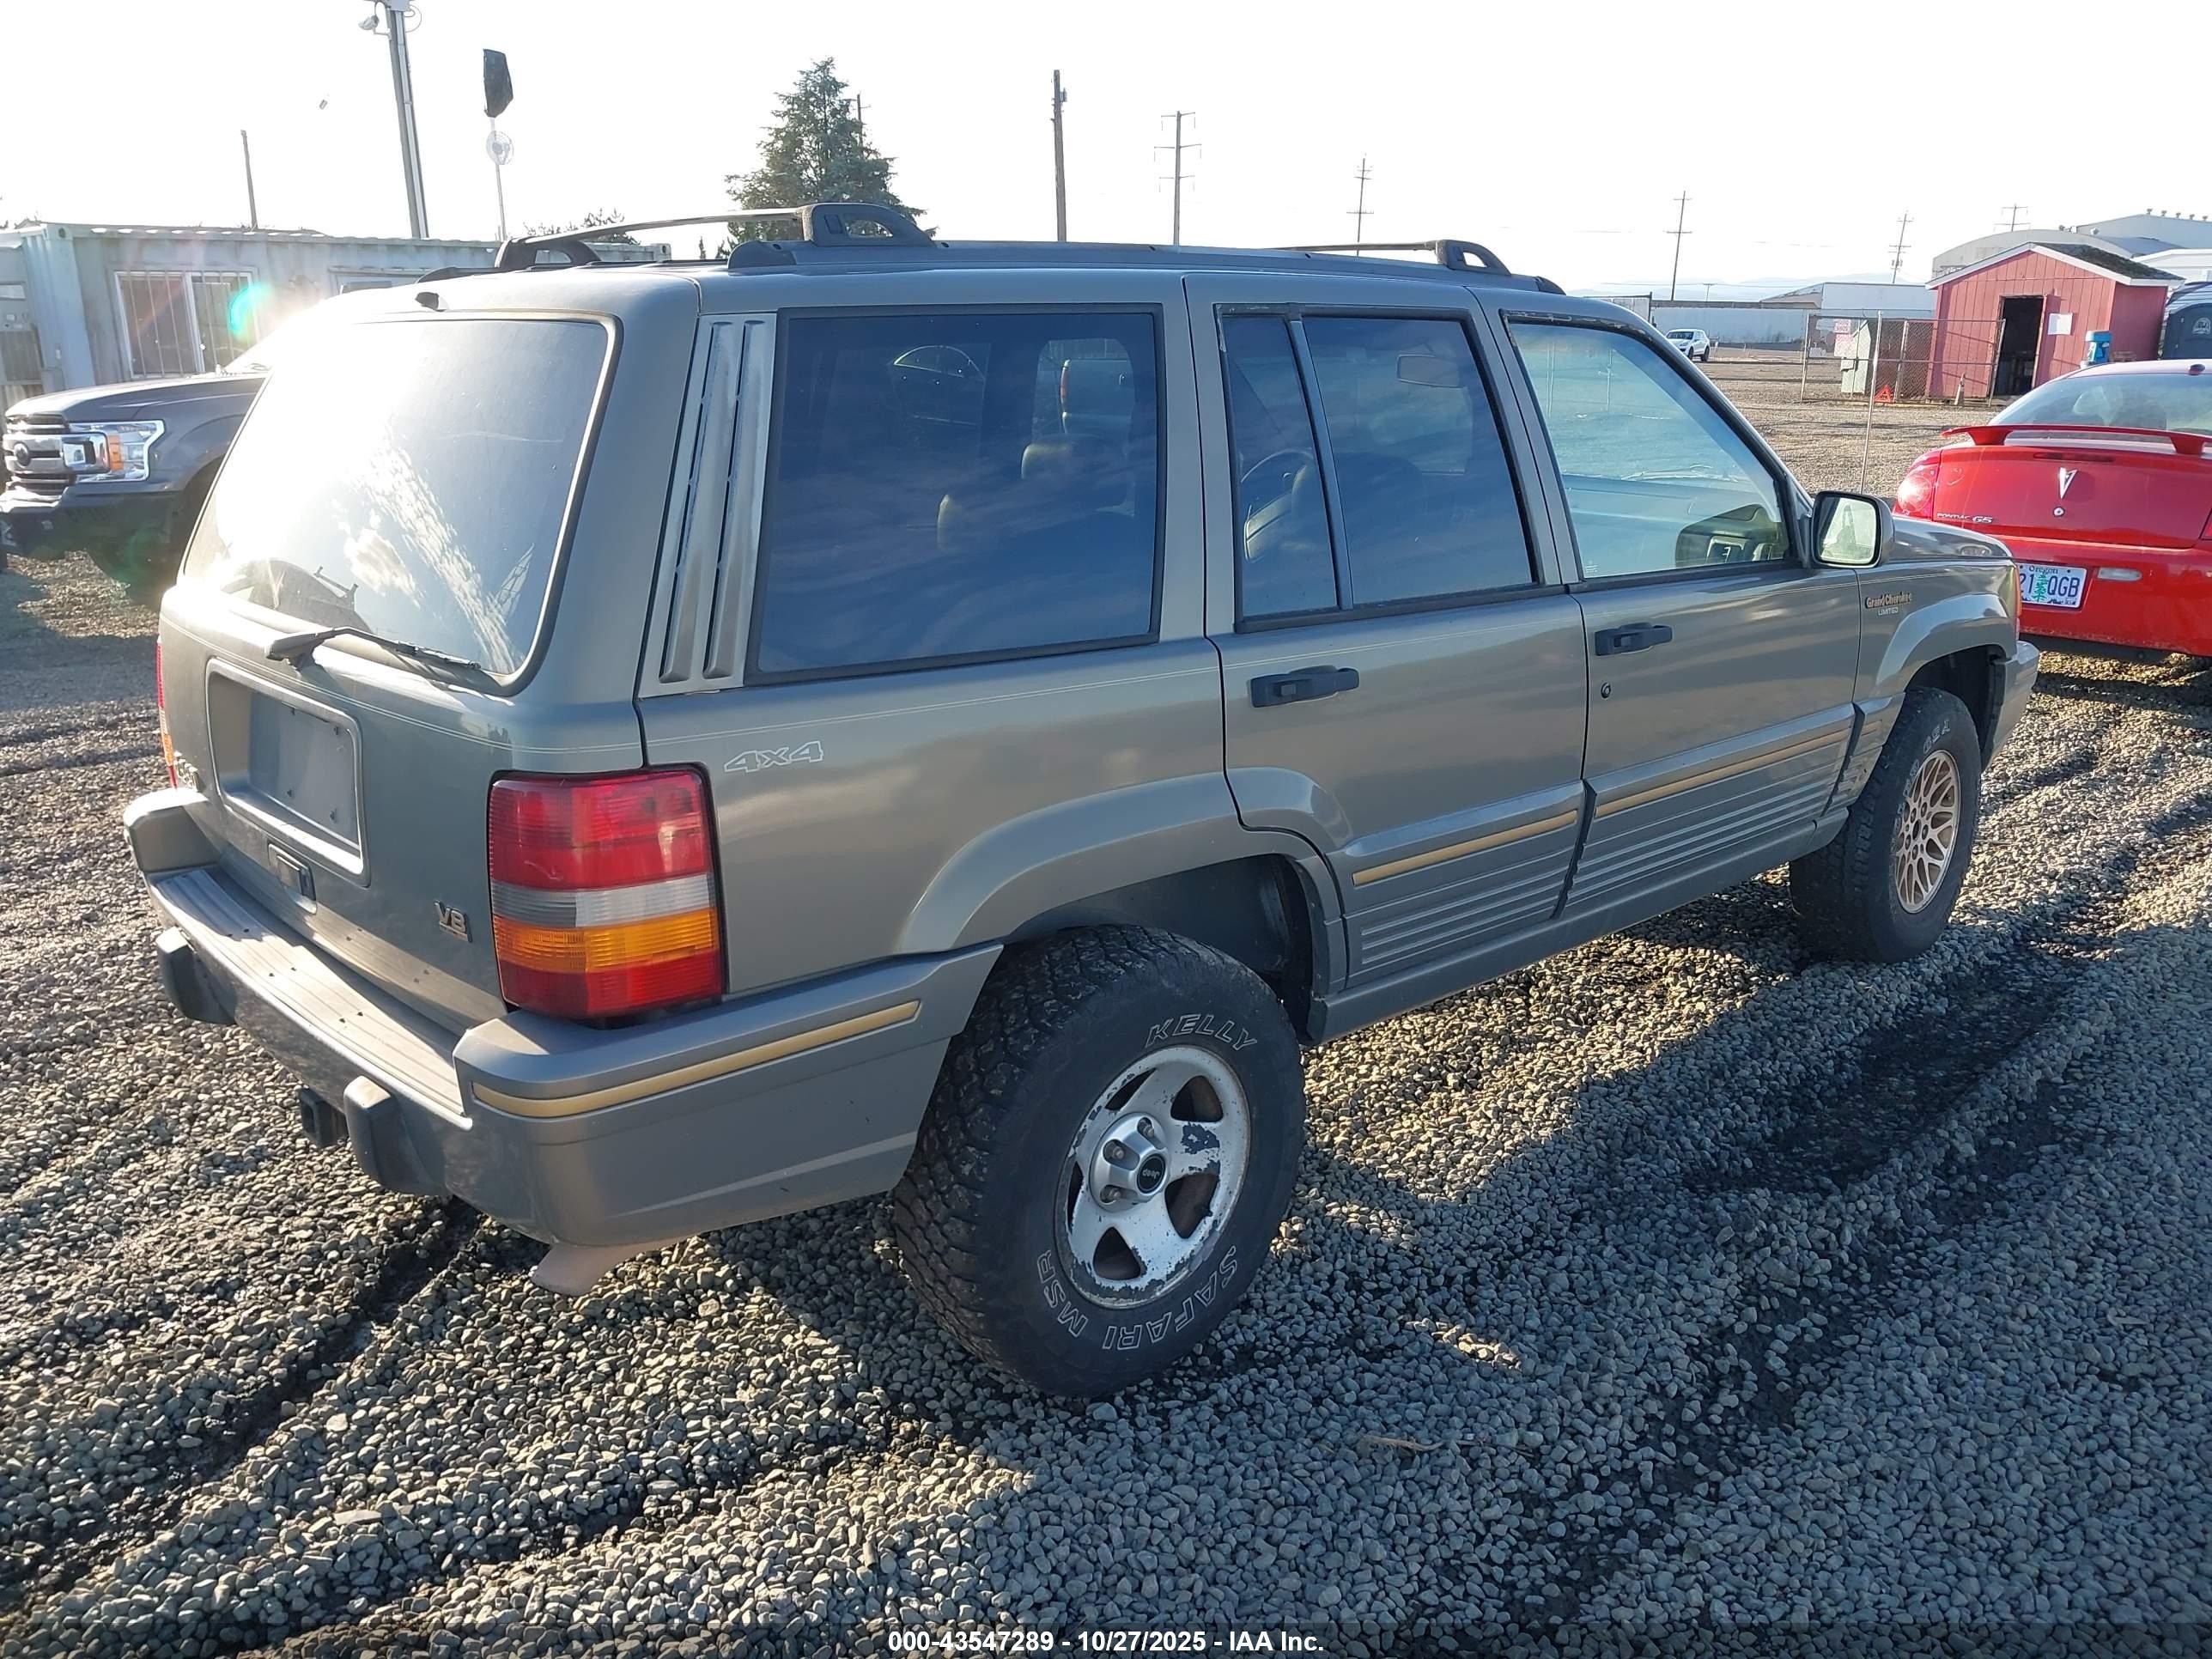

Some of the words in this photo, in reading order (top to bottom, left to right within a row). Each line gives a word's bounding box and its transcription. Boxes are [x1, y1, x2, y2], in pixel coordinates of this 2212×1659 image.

[1972, 515, 1993, 524] G5
[2028, 564, 2059, 575] Oregon
[2046, 575, 2081, 598] QGB
[1877, 606, 1899, 617] LIMITED
[434, 901, 467, 934] V8
[1144, 1012, 1259, 1051] KELLY
[1036, 1249, 1089, 1338] MSR
[1102, 1244, 1238, 1351] SAFARI
